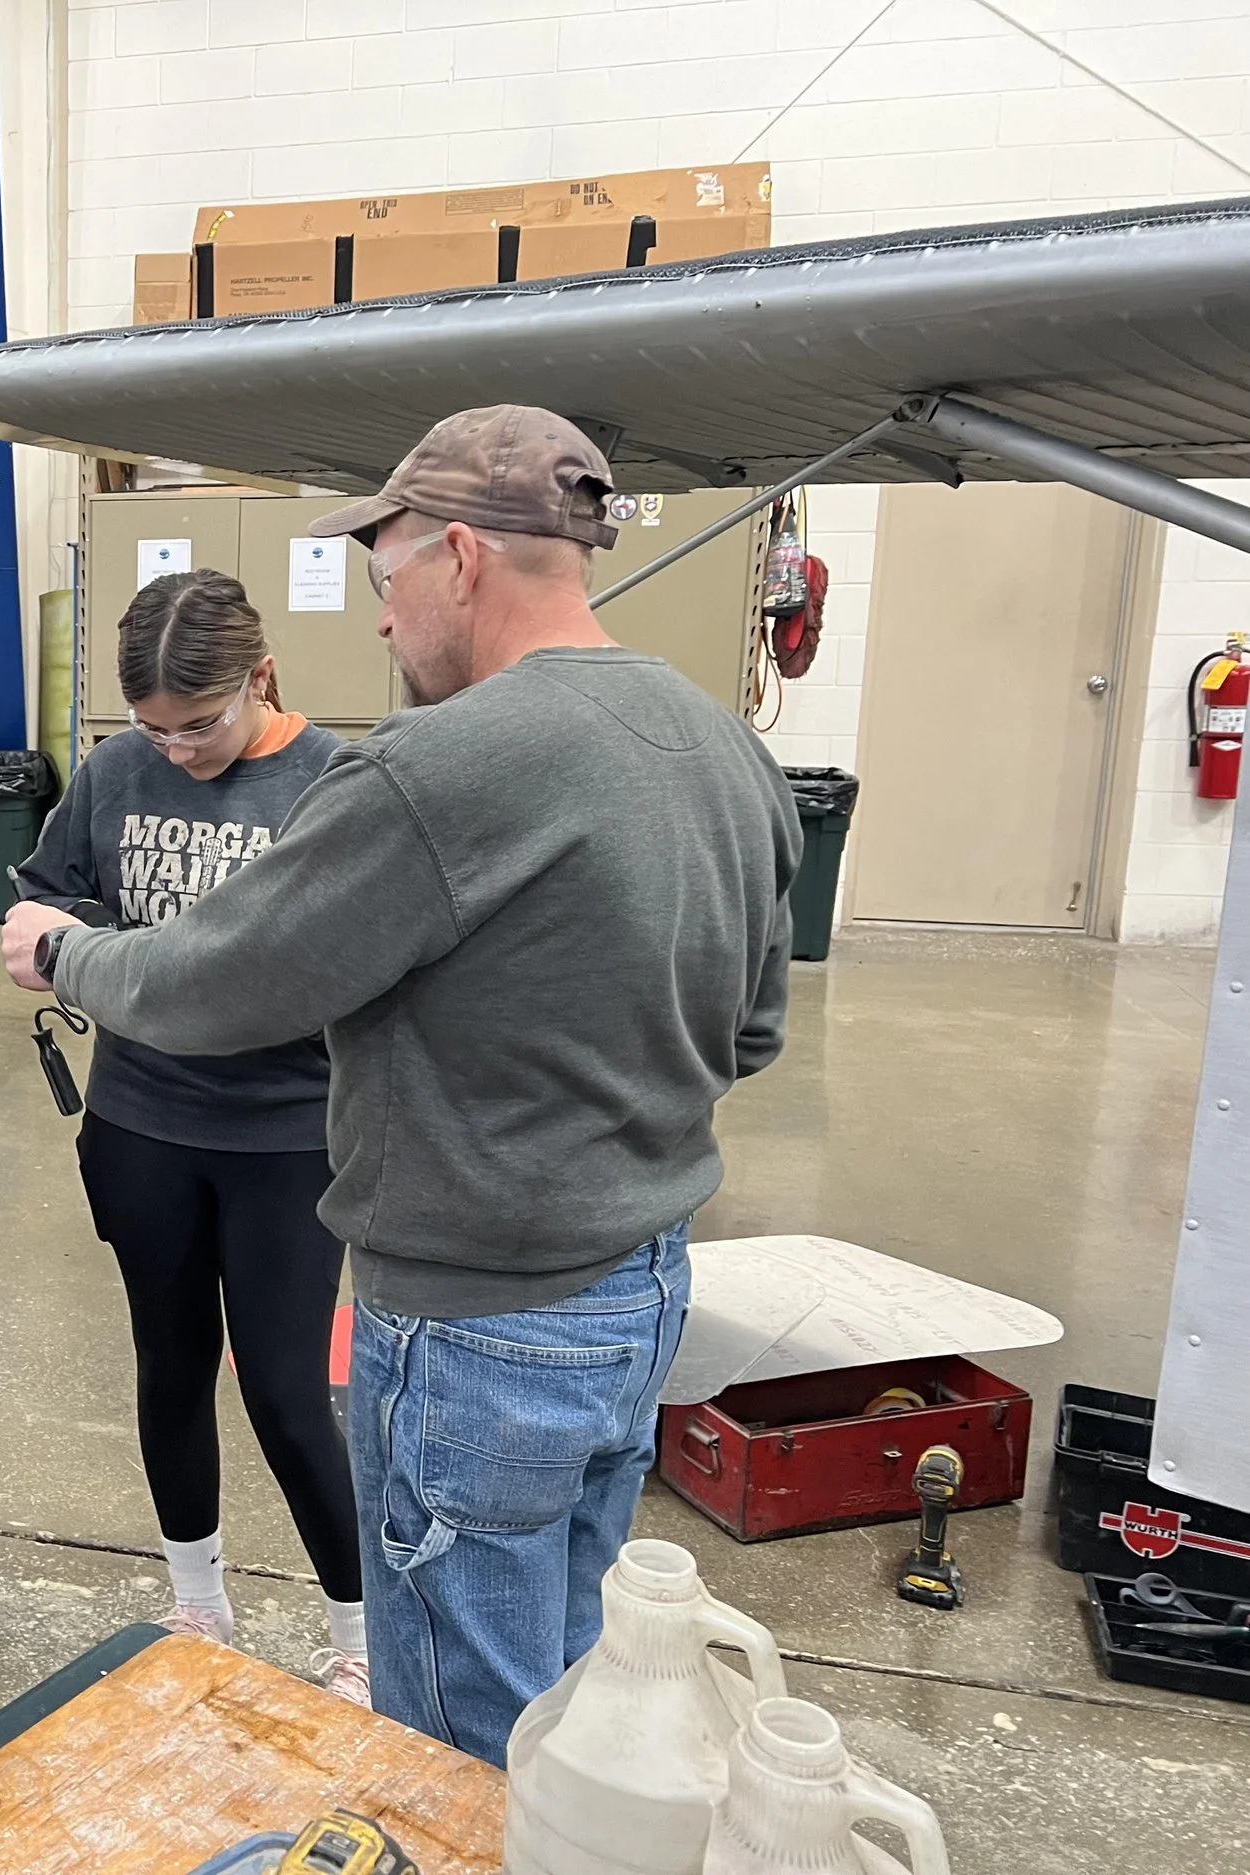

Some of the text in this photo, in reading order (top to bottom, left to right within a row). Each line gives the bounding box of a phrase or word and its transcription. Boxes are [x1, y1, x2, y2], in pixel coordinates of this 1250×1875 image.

[570, 182, 598, 195] DO NOT
[366, 207, 389, 219] END
[119, 814, 282, 861] MORGA
